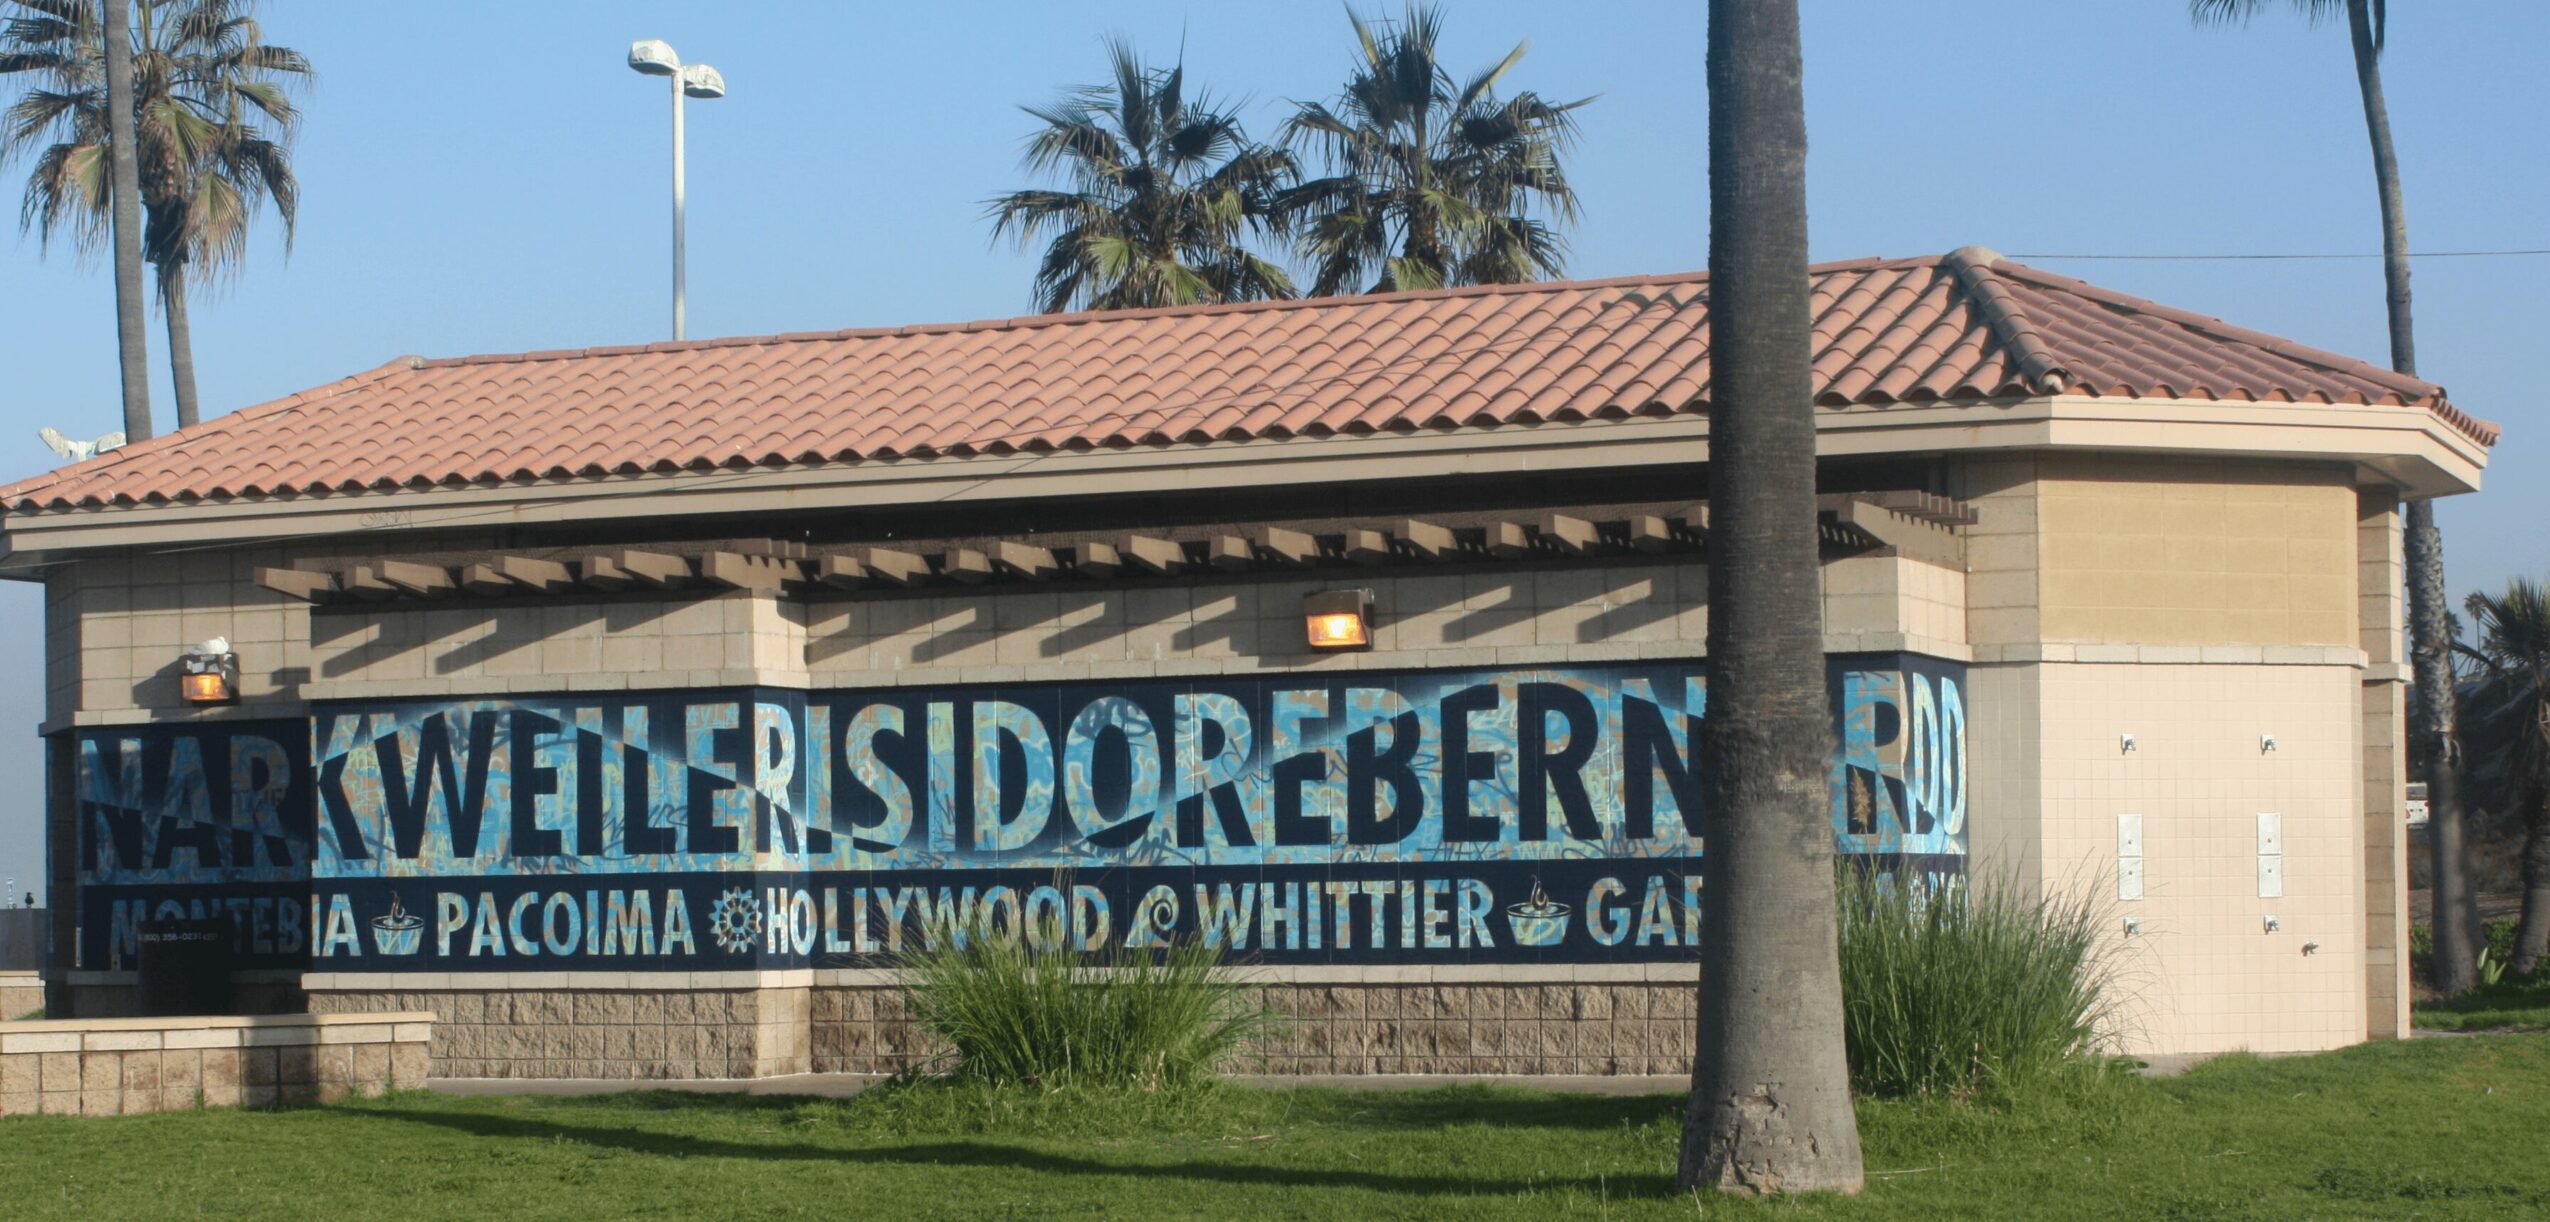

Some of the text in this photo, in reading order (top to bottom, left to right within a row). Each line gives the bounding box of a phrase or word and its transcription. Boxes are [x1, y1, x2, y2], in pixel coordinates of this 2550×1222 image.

[437, 889, 696, 956] PACOIMA
[767, 884, 1110, 955] HOLLYWOOD
[1195, 879, 1495, 950] WHITTIER
